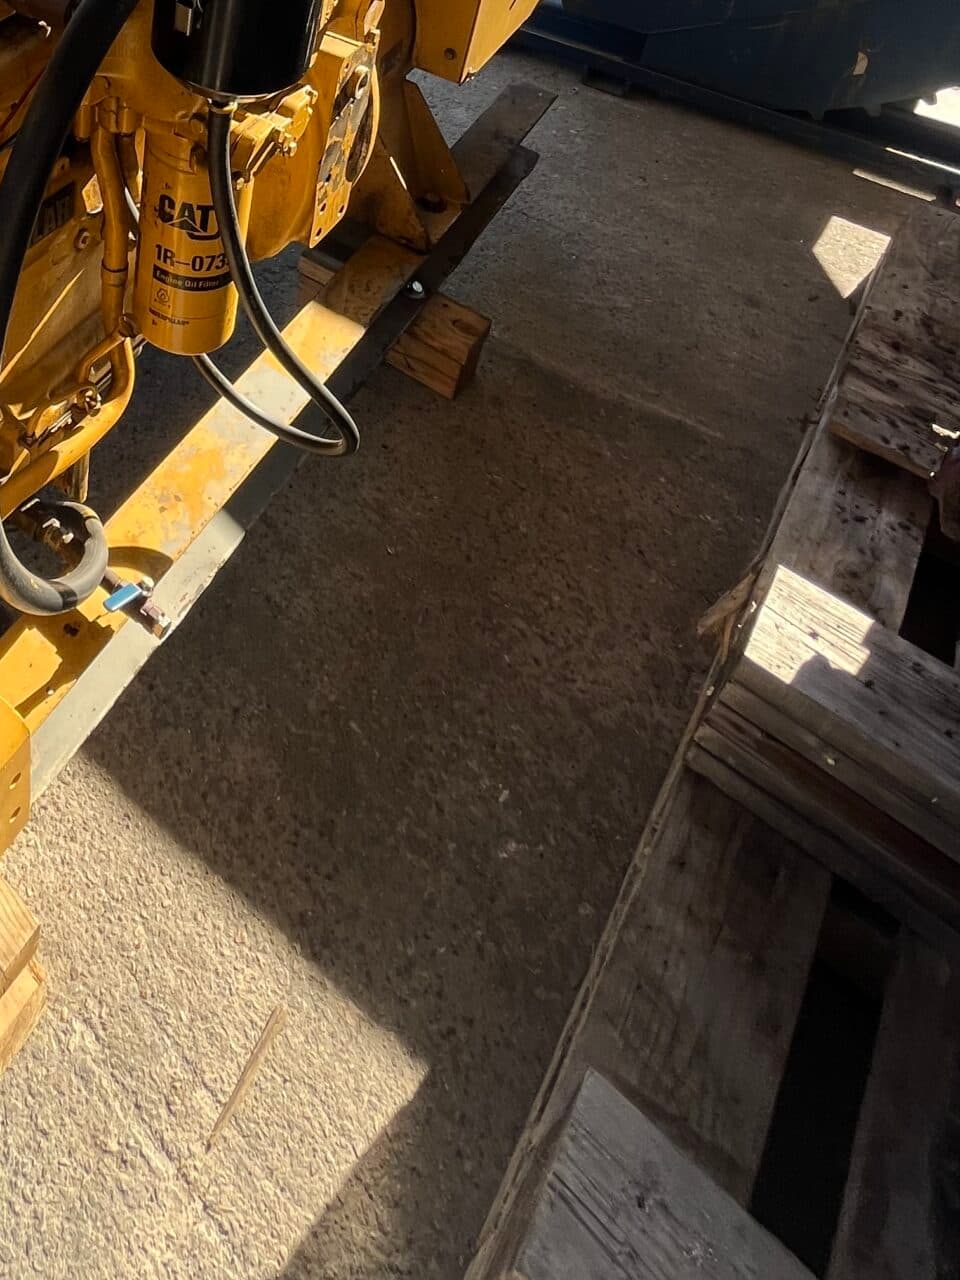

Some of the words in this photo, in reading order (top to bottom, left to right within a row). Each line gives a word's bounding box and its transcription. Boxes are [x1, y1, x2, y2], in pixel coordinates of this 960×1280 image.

[158, 194, 215, 233] CAT
[155, 244, 230, 272] 1R-073
[155, 270, 183, 288] Engine
[184, 280, 197, 288] Oil
